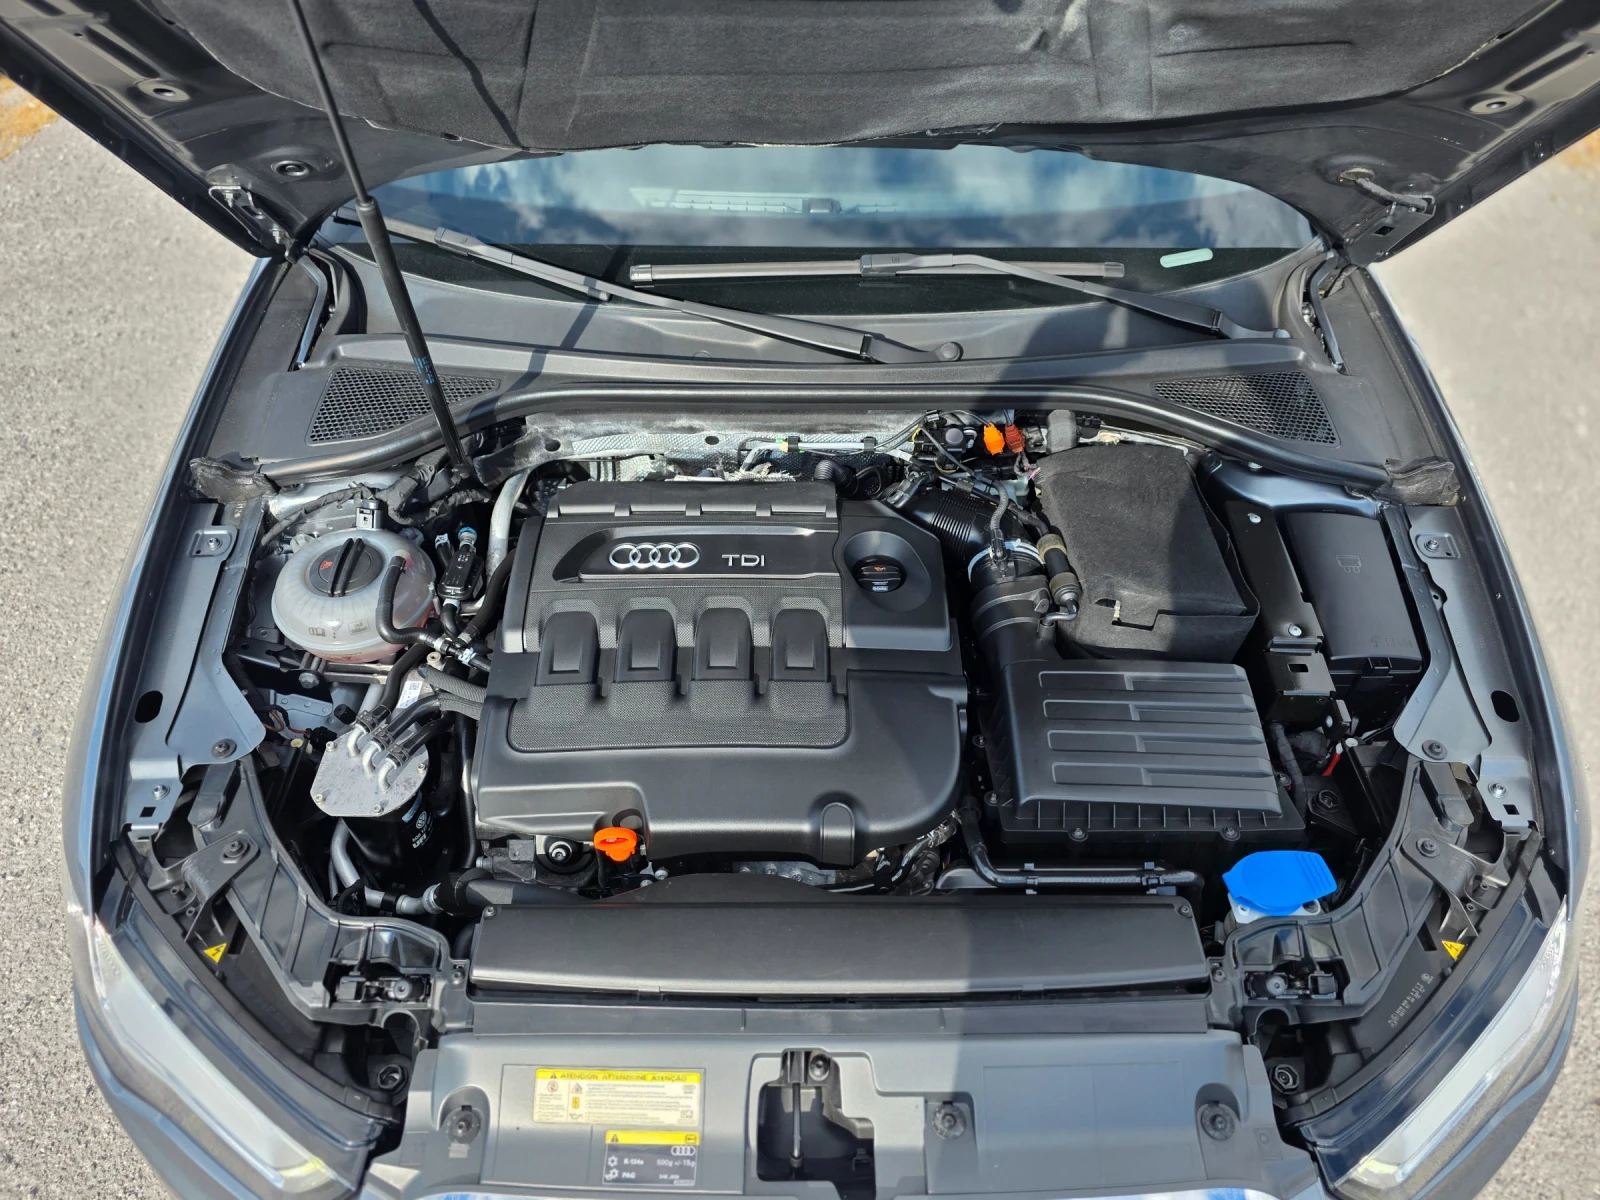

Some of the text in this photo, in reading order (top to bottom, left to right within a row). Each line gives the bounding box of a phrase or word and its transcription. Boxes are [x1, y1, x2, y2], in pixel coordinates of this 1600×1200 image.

[722, 554, 765, 567] TDI
[656, 1158, 673, 1168] 500g
[683, 1159, 695, 1168] 15g
[621, 1171, 636, 1179] PAG
